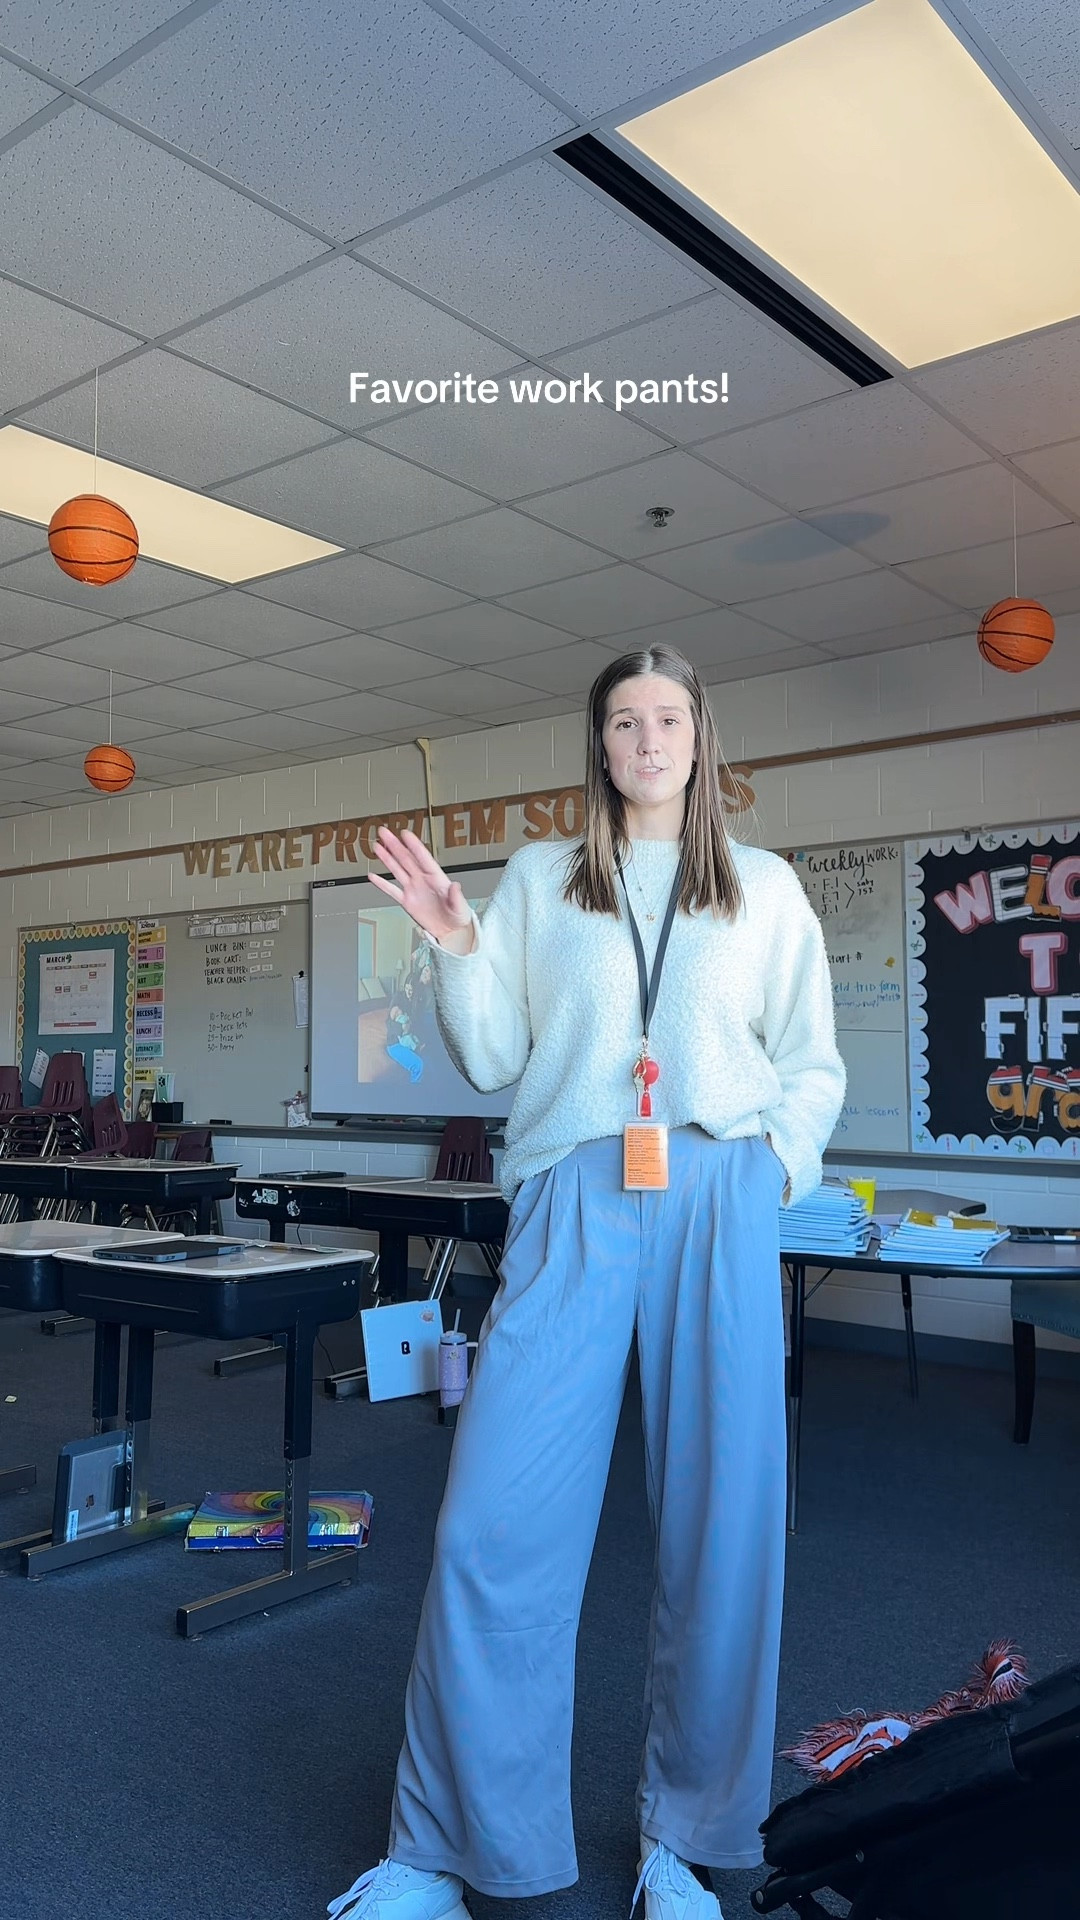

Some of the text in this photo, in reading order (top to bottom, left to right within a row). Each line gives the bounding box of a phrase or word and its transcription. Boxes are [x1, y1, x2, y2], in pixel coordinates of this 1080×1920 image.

[183, 840, 231, 878] WE
[236, 828, 304, 873] ARE
[934, 854, 1080, 934] WELC
[205, 943, 227, 953] LUNCH
[1019, 932, 1080, 994] T
[136, 1009, 154, 1017] RECESS
[136, 1027, 151, 1035] LUNCH
[981, 994, 1080, 1062] FIF
[987, 1065, 1080, 1133] gra
